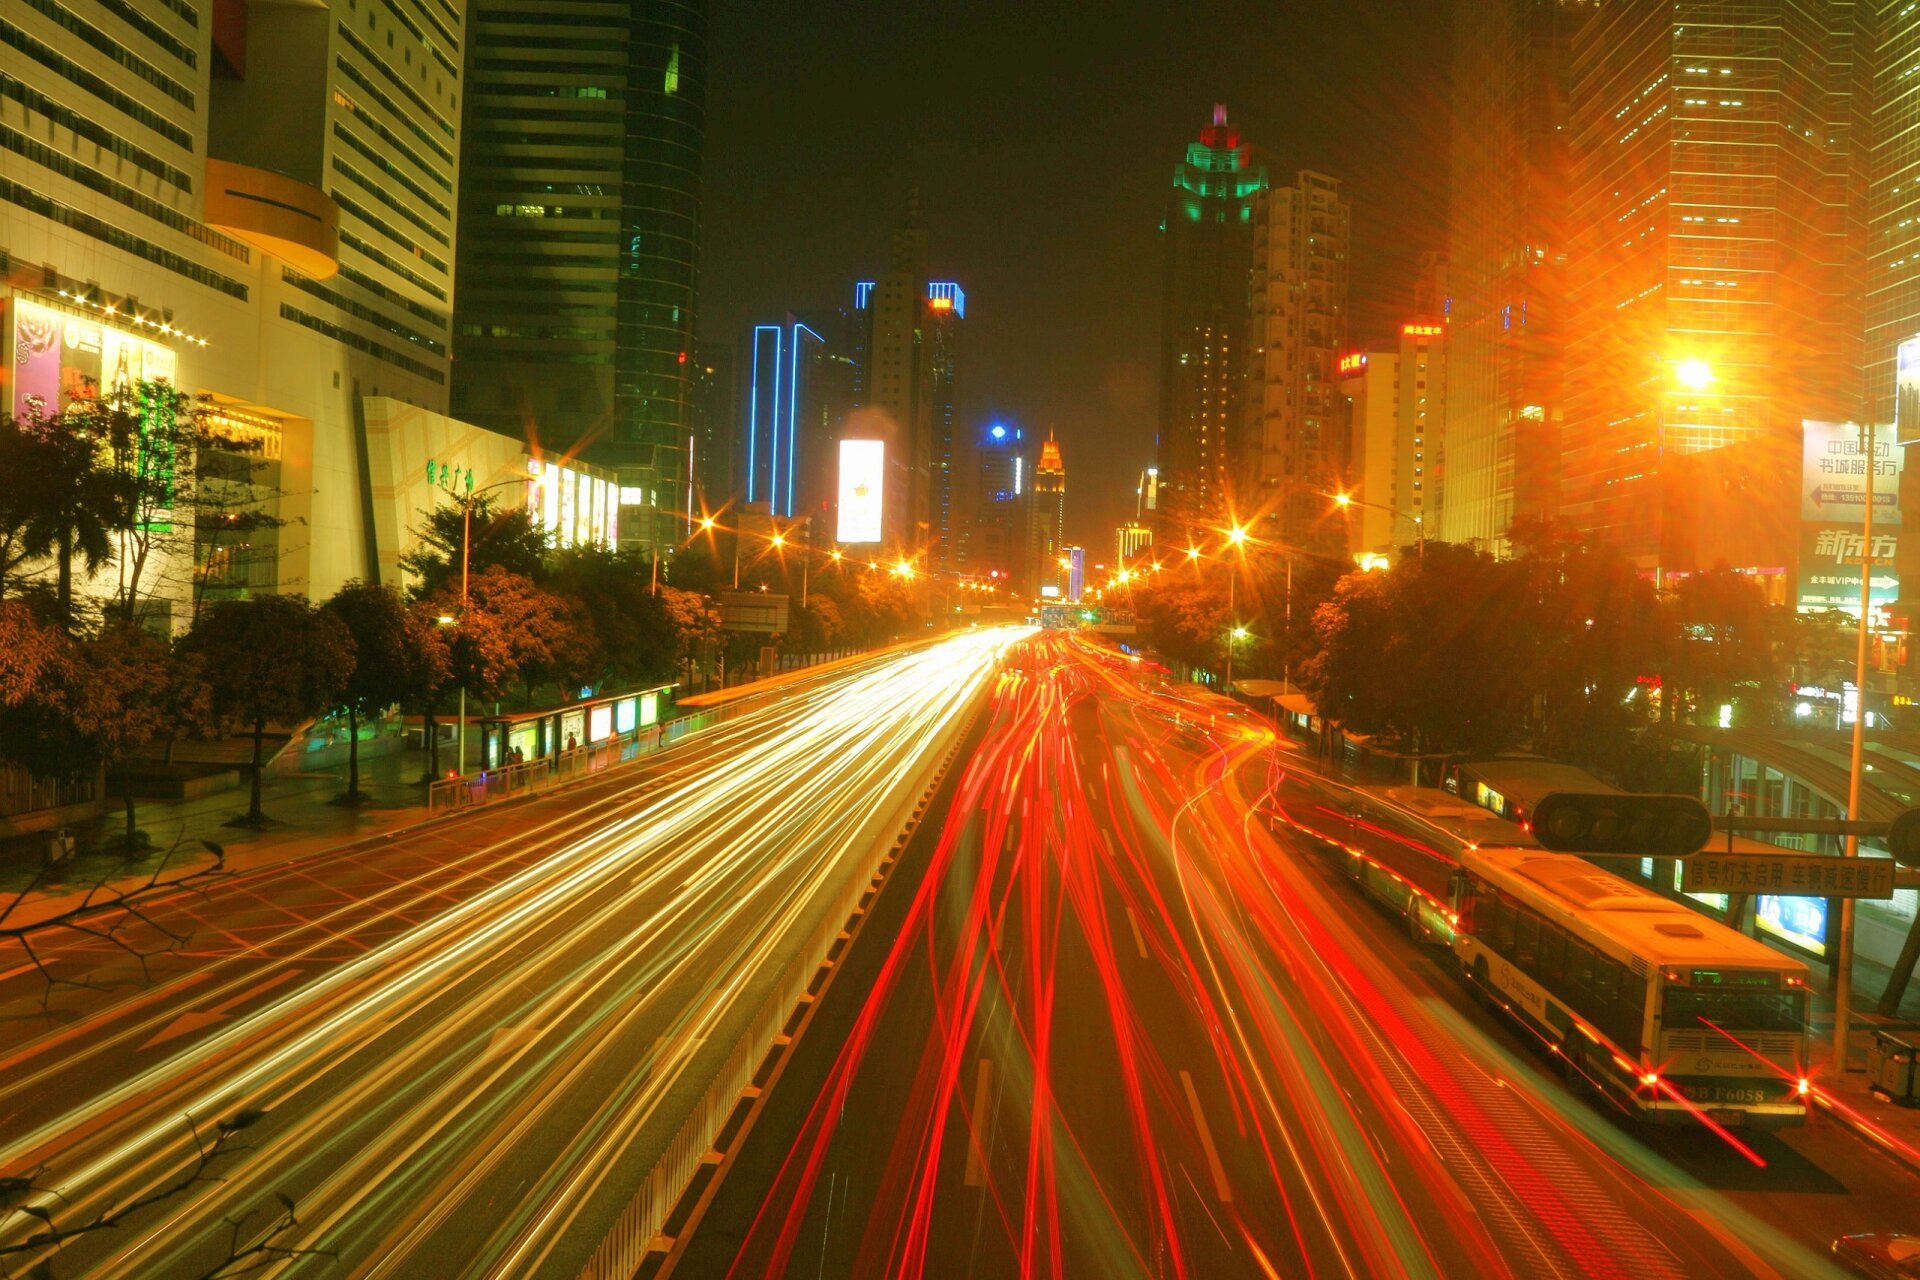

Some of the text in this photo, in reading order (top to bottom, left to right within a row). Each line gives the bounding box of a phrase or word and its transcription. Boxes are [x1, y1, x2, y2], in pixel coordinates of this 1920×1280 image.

[1815, 529, 1897, 564] 新东方
[1691, 859, 1888, 892] 信号灯未启用 车辆减速慢行
[1715, 1087, 1765, 1102] F6058
